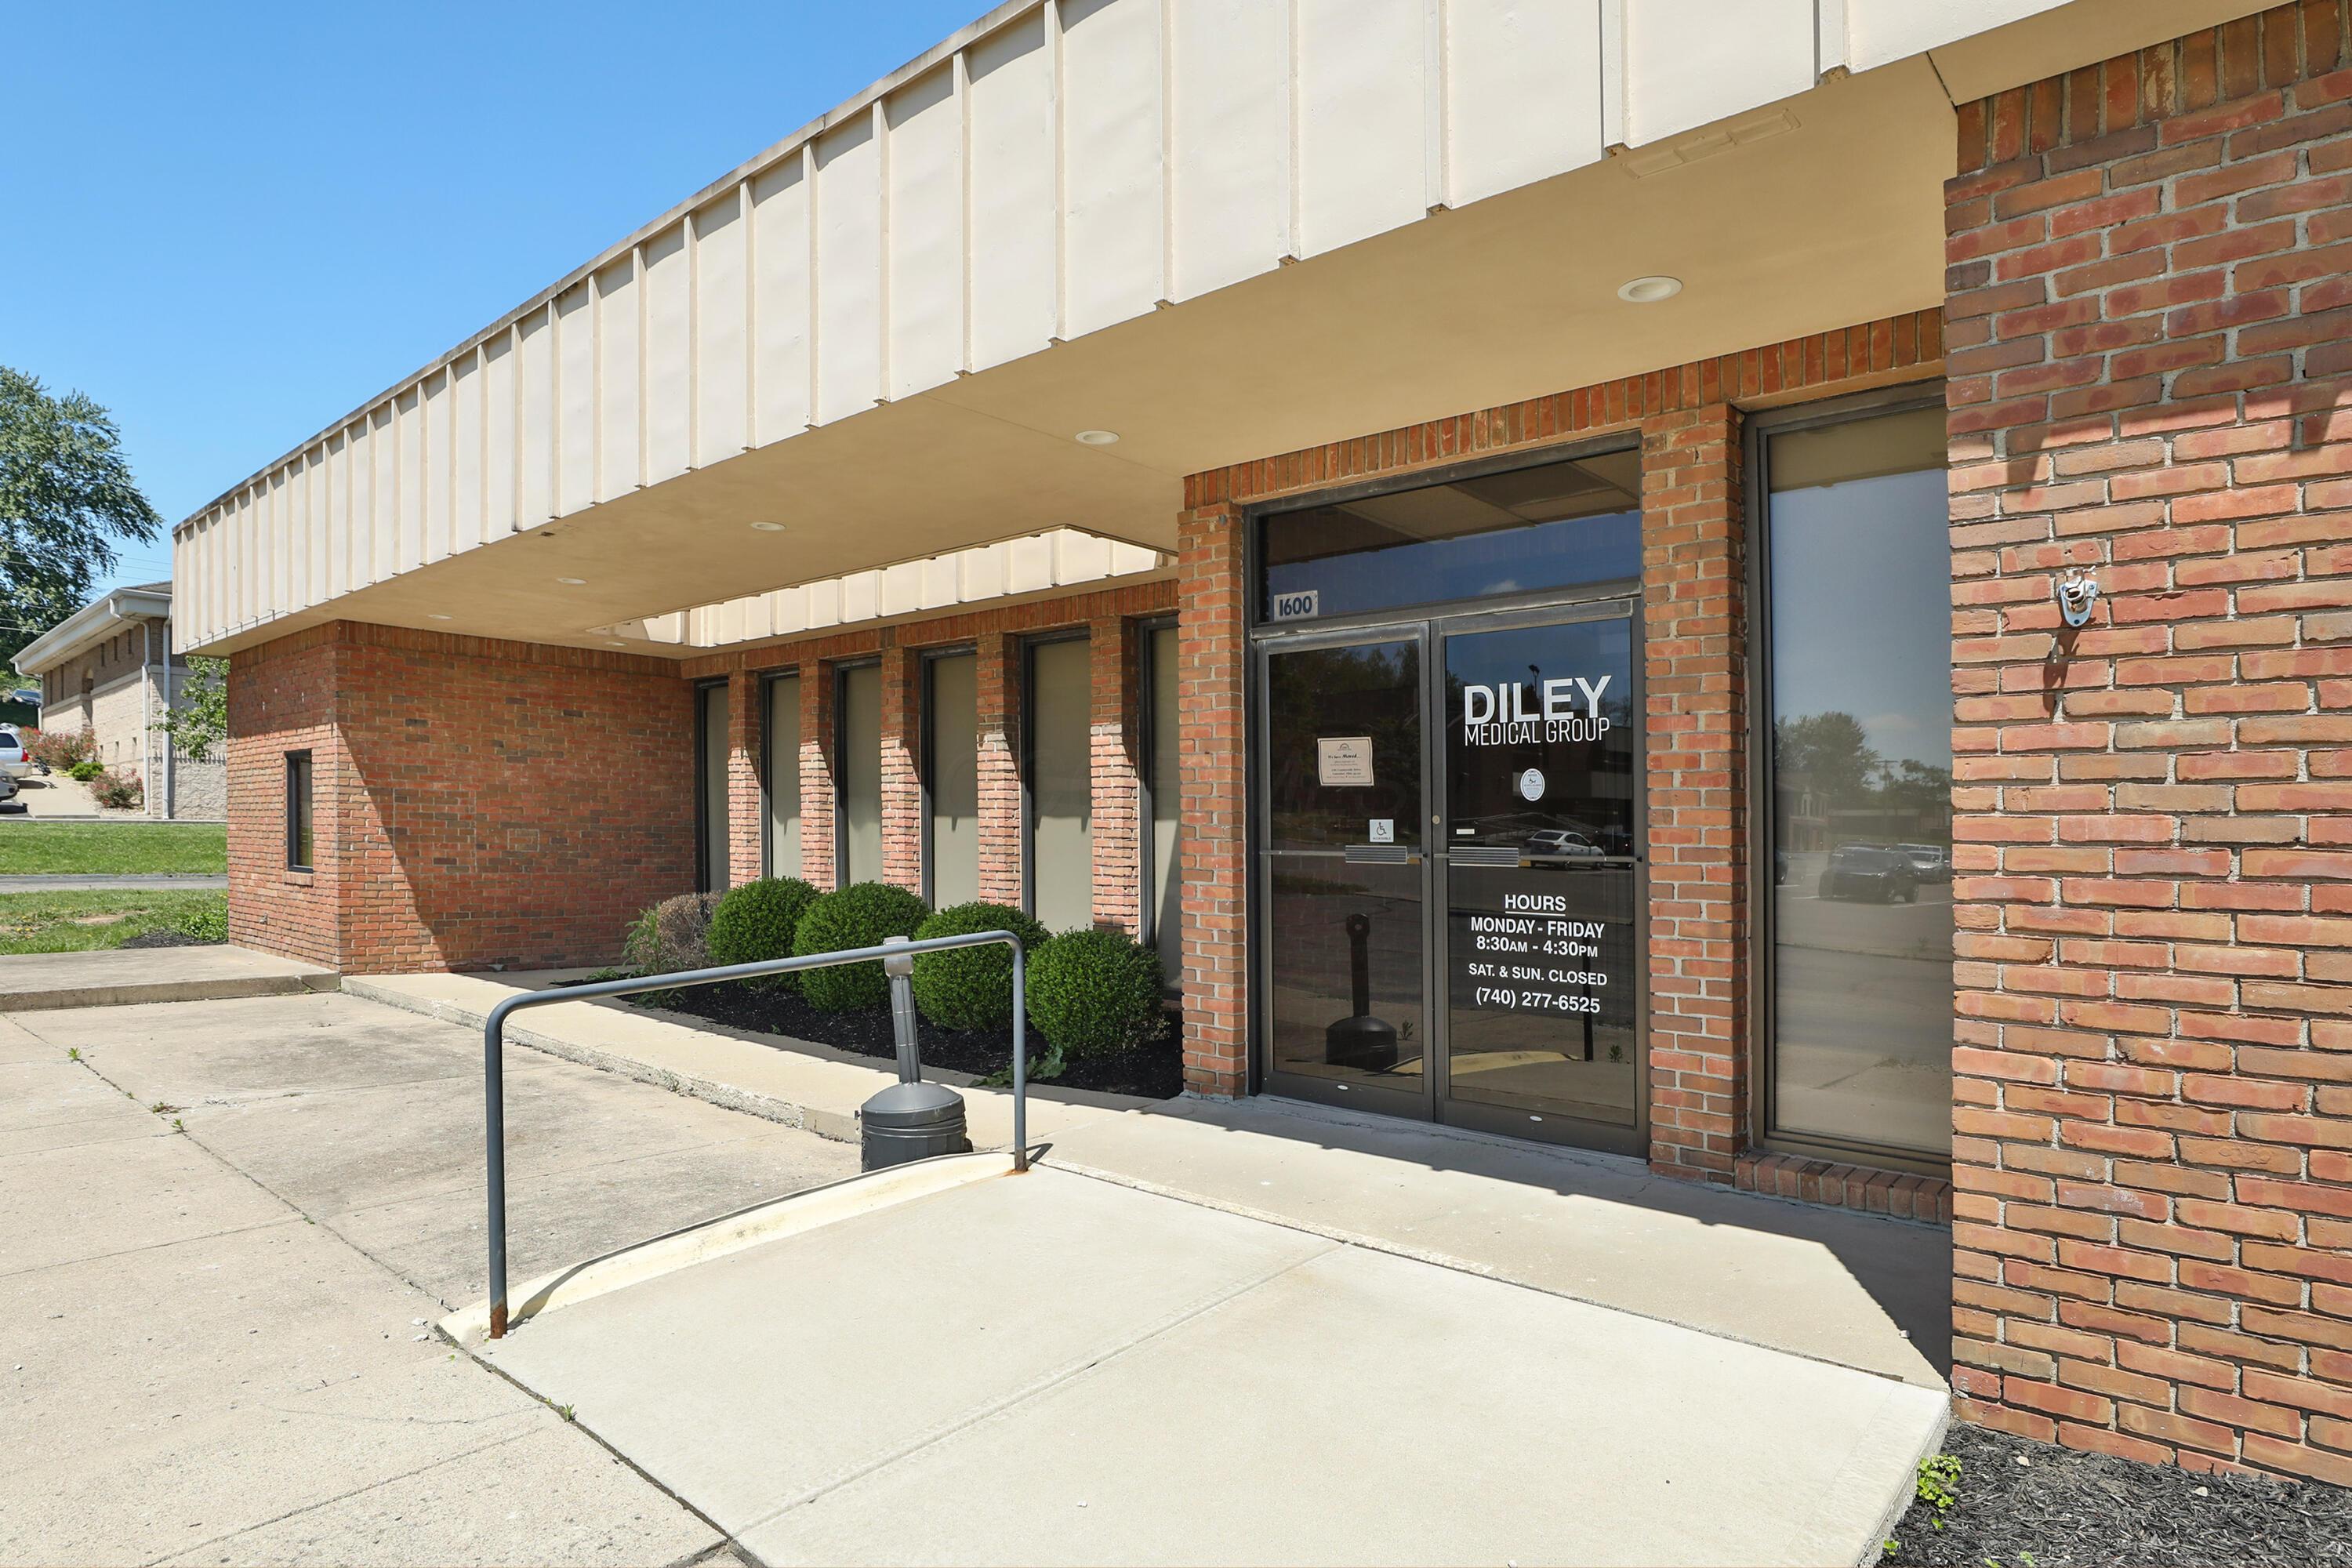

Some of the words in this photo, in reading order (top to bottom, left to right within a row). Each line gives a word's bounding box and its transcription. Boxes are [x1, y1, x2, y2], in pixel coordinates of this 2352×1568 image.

[1279, 596, 1312, 616] 1600
[1465, 675, 1612, 724] DILEY
[1465, 720, 1541, 746] MEDICAL
[1545, 717, 1610, 743] GROUP
[1504, 894, 1566, 912] HOURS
[1471, 916, 1536, 935] MONDAY
[1548, 920, 1605, 939] FRIDAY
[1476, 935, 1528, 953] 8:30AM
[1543, 939, 1599, 957] 4:30PM
[1468, 963, 1496, 977] SAT.
[1499, 965, 1508, 978] &
[1512, 966, 1544, 981] SUN.
[1548, 969, 1608, 986] CLOSED
[1475, 986, 1516, 1009] (740)
[1521, 991, 1601, 1014] 277-6525
